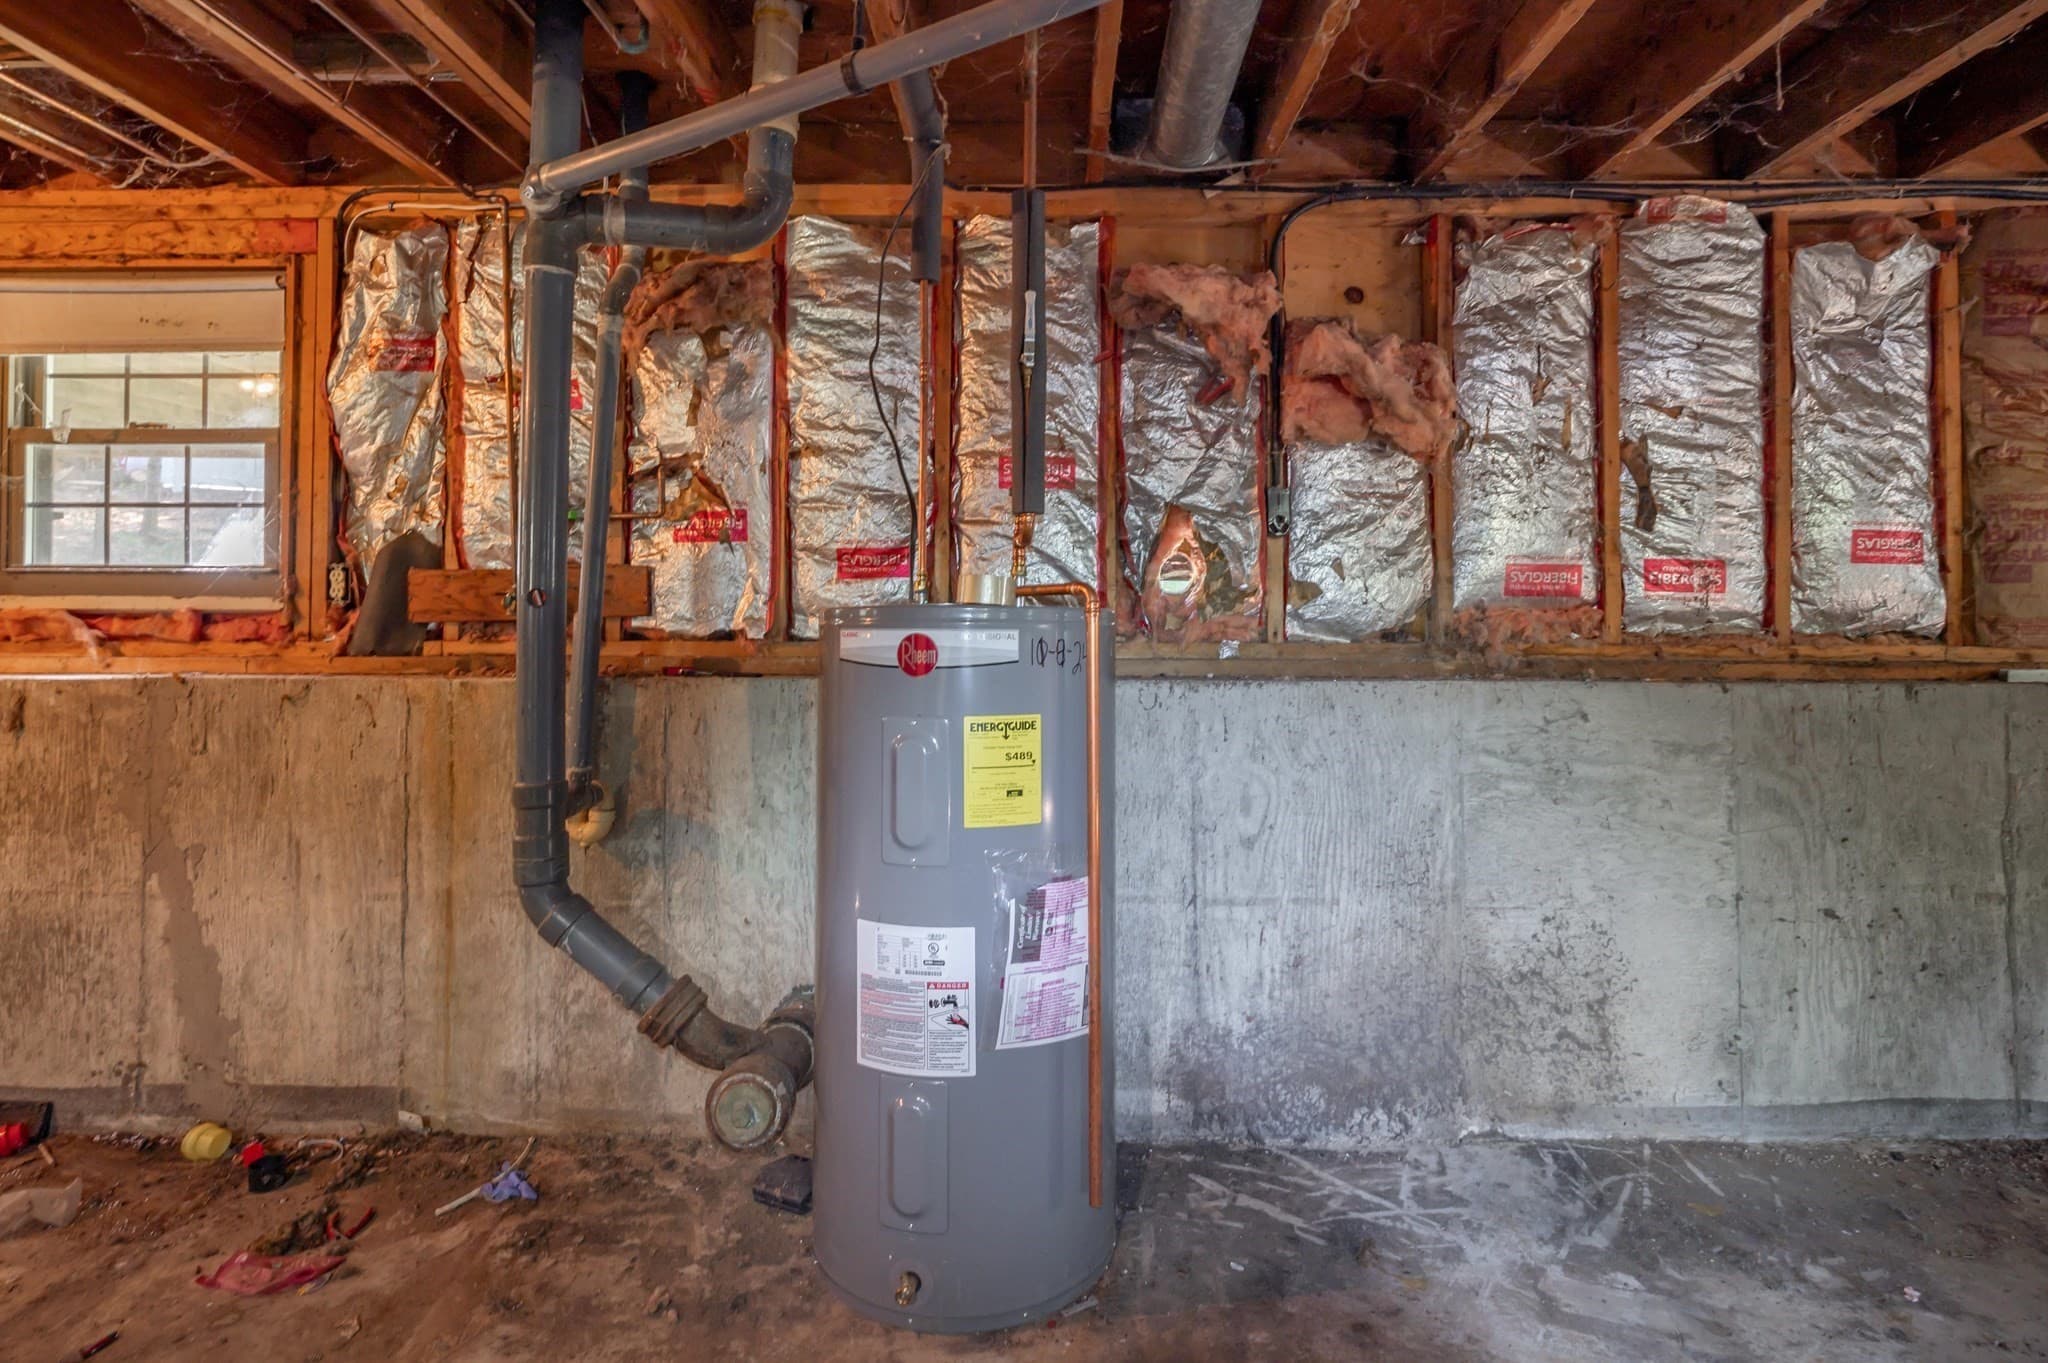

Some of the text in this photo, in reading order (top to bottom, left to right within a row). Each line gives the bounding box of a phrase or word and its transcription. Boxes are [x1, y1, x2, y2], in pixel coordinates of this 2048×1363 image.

[1510, 571, 1578, 585] FIBERGLAS
[902, 634, 936, 670] Rheem
[970, 720, 1037, 734] ENERGYGUIDE
[1005, 752, 1033, 761] $489
